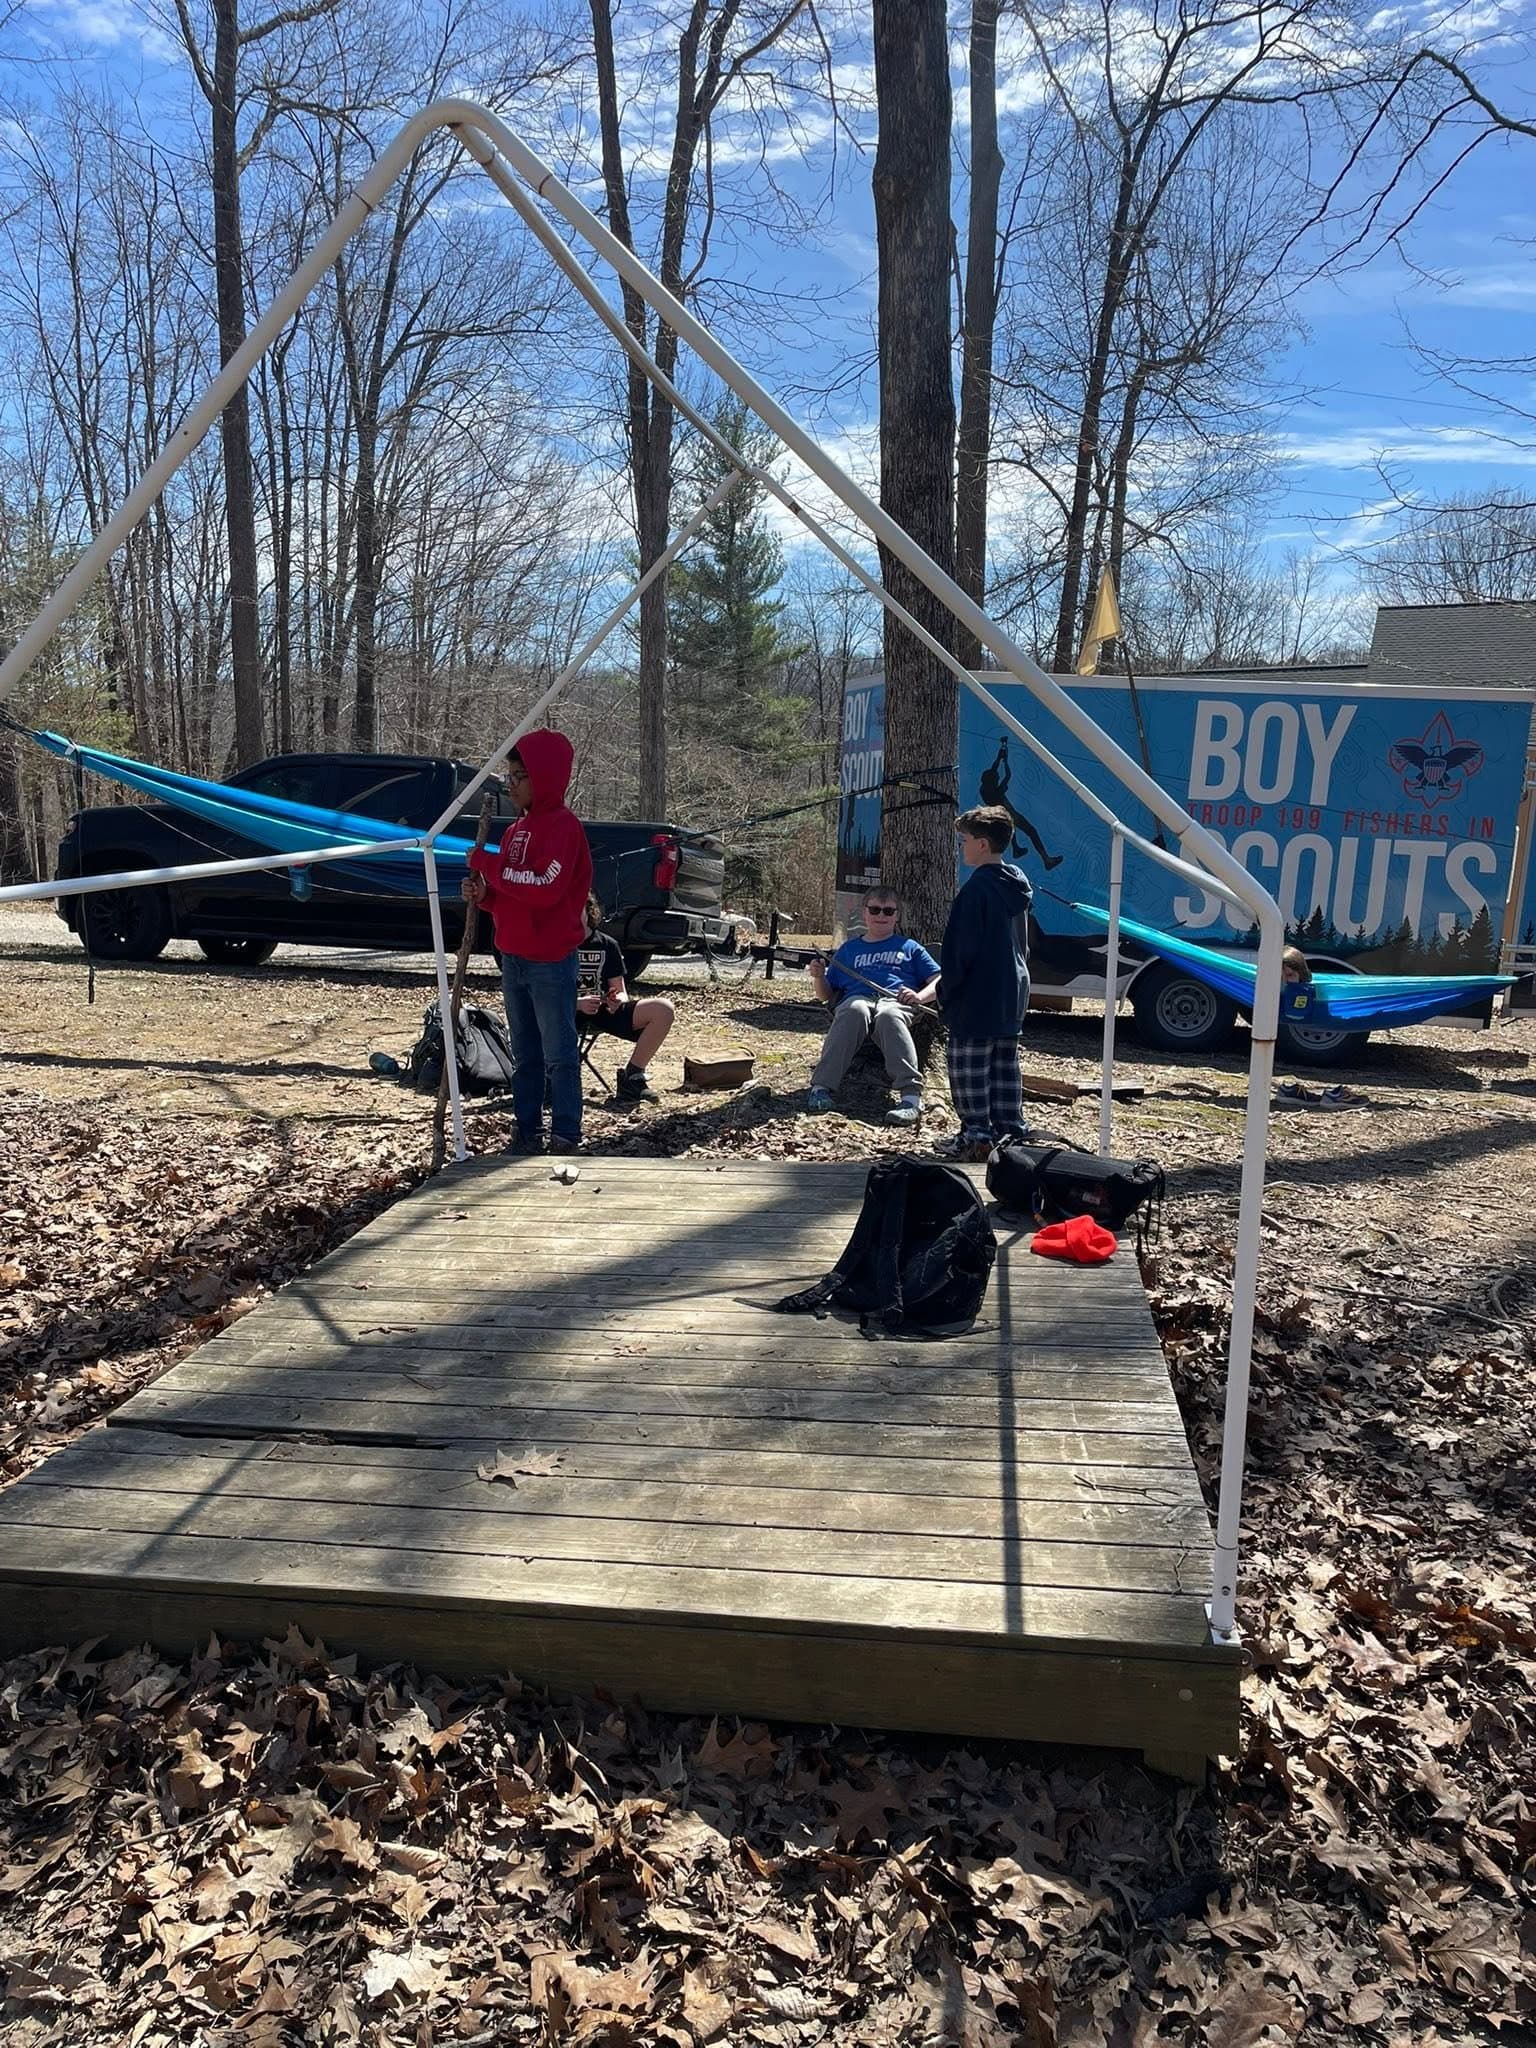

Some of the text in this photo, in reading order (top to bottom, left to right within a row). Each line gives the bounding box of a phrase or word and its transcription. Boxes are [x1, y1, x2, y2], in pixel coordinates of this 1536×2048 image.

[844, 691, 871, 741] BOY
[1188, 700, 1358, 806] BOY
[1188, 803, 1262, 827] TROOP
[1279, 806, 1321, 831] 199
[1469, 816, 1495, 840] IN
[1173, 828, 1497, 948] SCOUTS
[588, 953, 600, 961] UP
[854, 951, 903, 968] FALCONS
